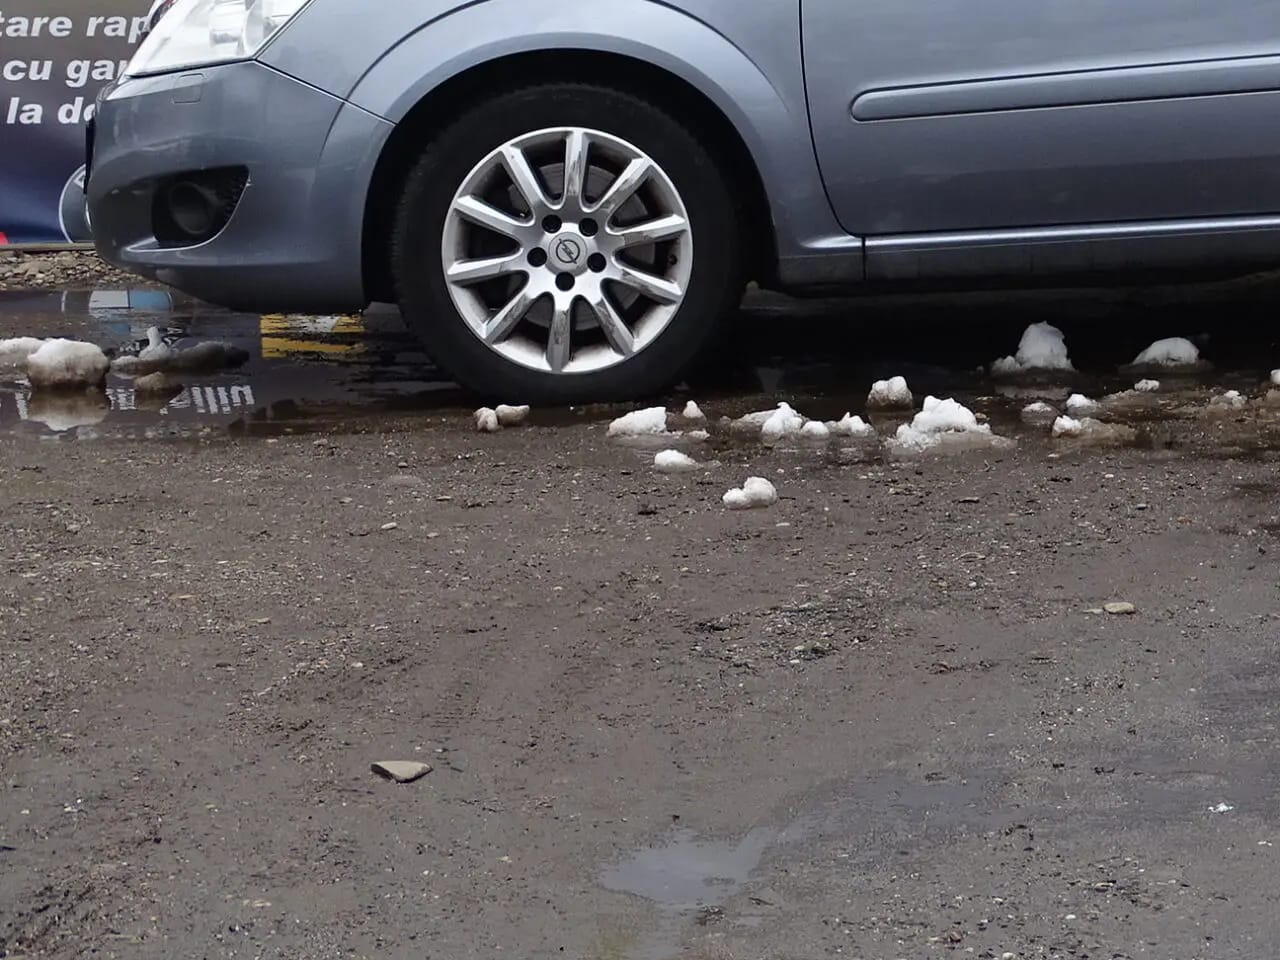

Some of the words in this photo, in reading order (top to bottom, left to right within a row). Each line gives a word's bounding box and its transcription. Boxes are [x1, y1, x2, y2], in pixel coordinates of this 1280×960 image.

[0, 10, 73, 37] are
[3, 59, 53, 81] cu
[6, 96, 43, 124] la
